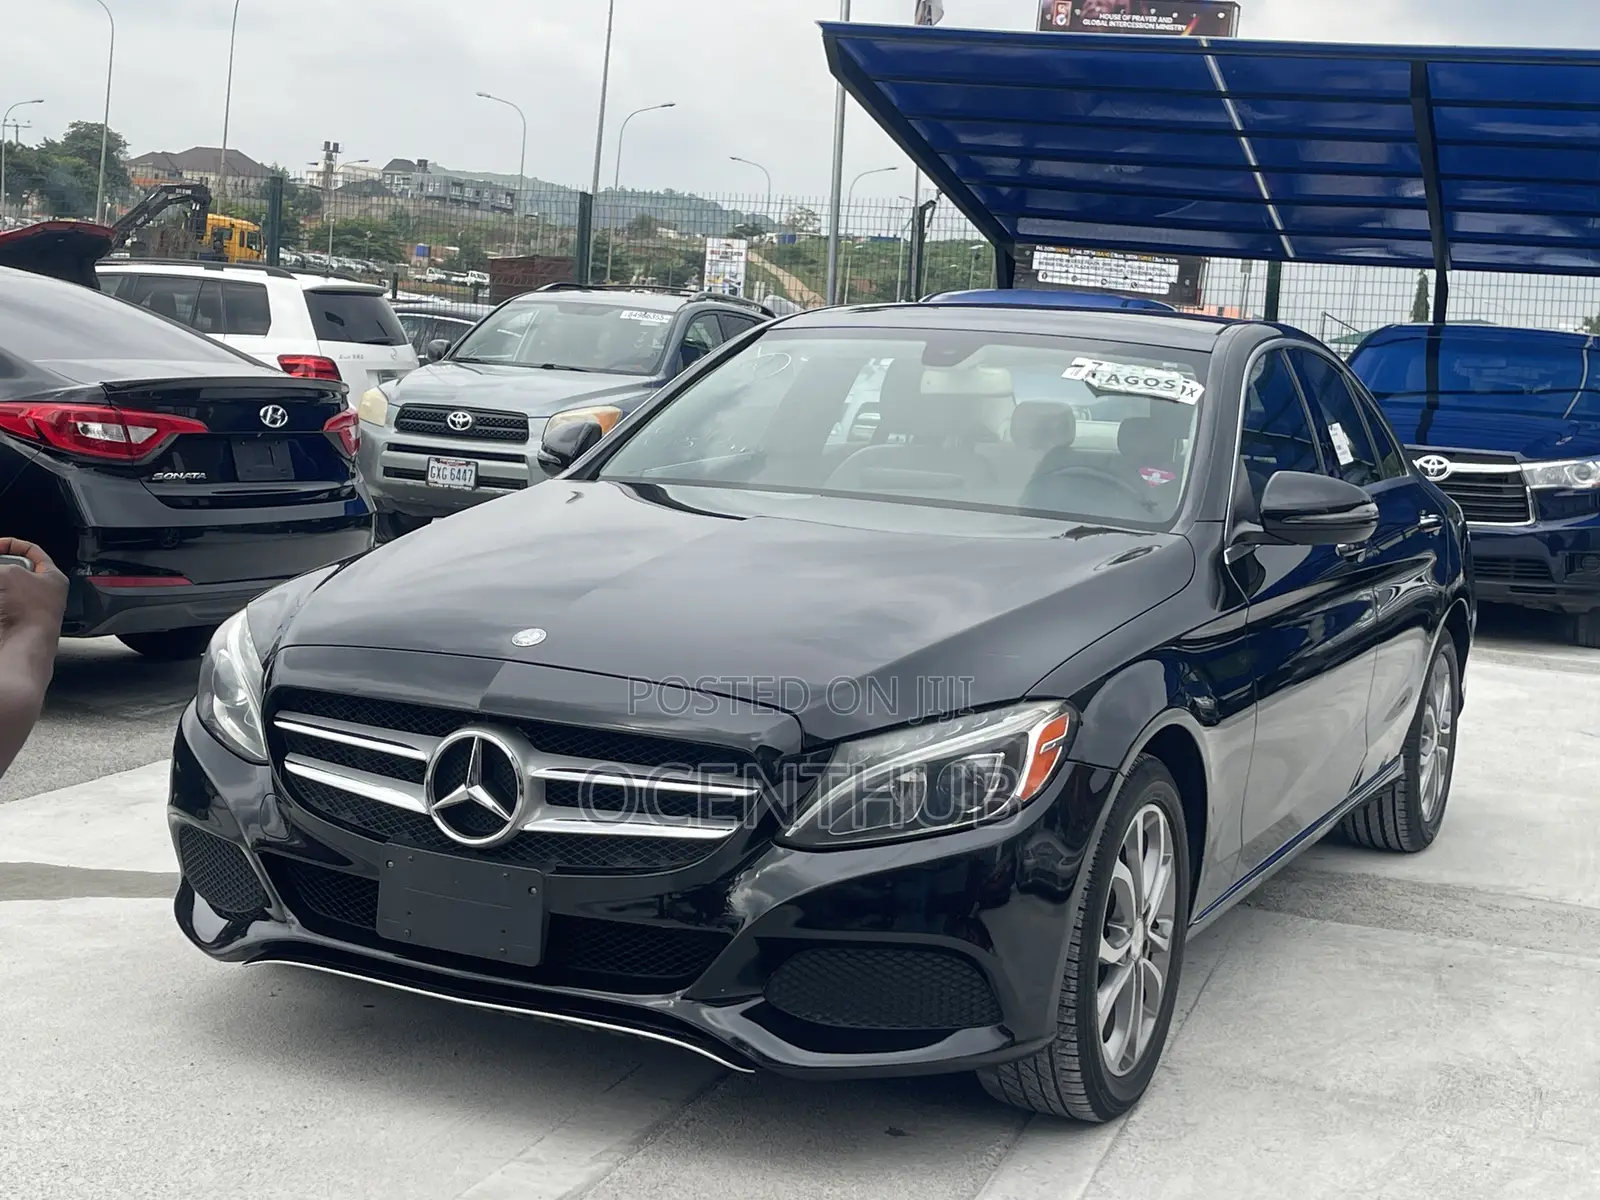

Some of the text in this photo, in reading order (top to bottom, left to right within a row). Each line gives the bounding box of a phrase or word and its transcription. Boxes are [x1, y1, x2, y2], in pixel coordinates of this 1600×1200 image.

[1082, 18, 1187, 31] GLOBAL INTERCESSION MINISTRY
[1091, 372, 1176, 389] AGOS
[152, 472, 207, 480] SONATA
[430, 465, 473, 482] GXG 6447
